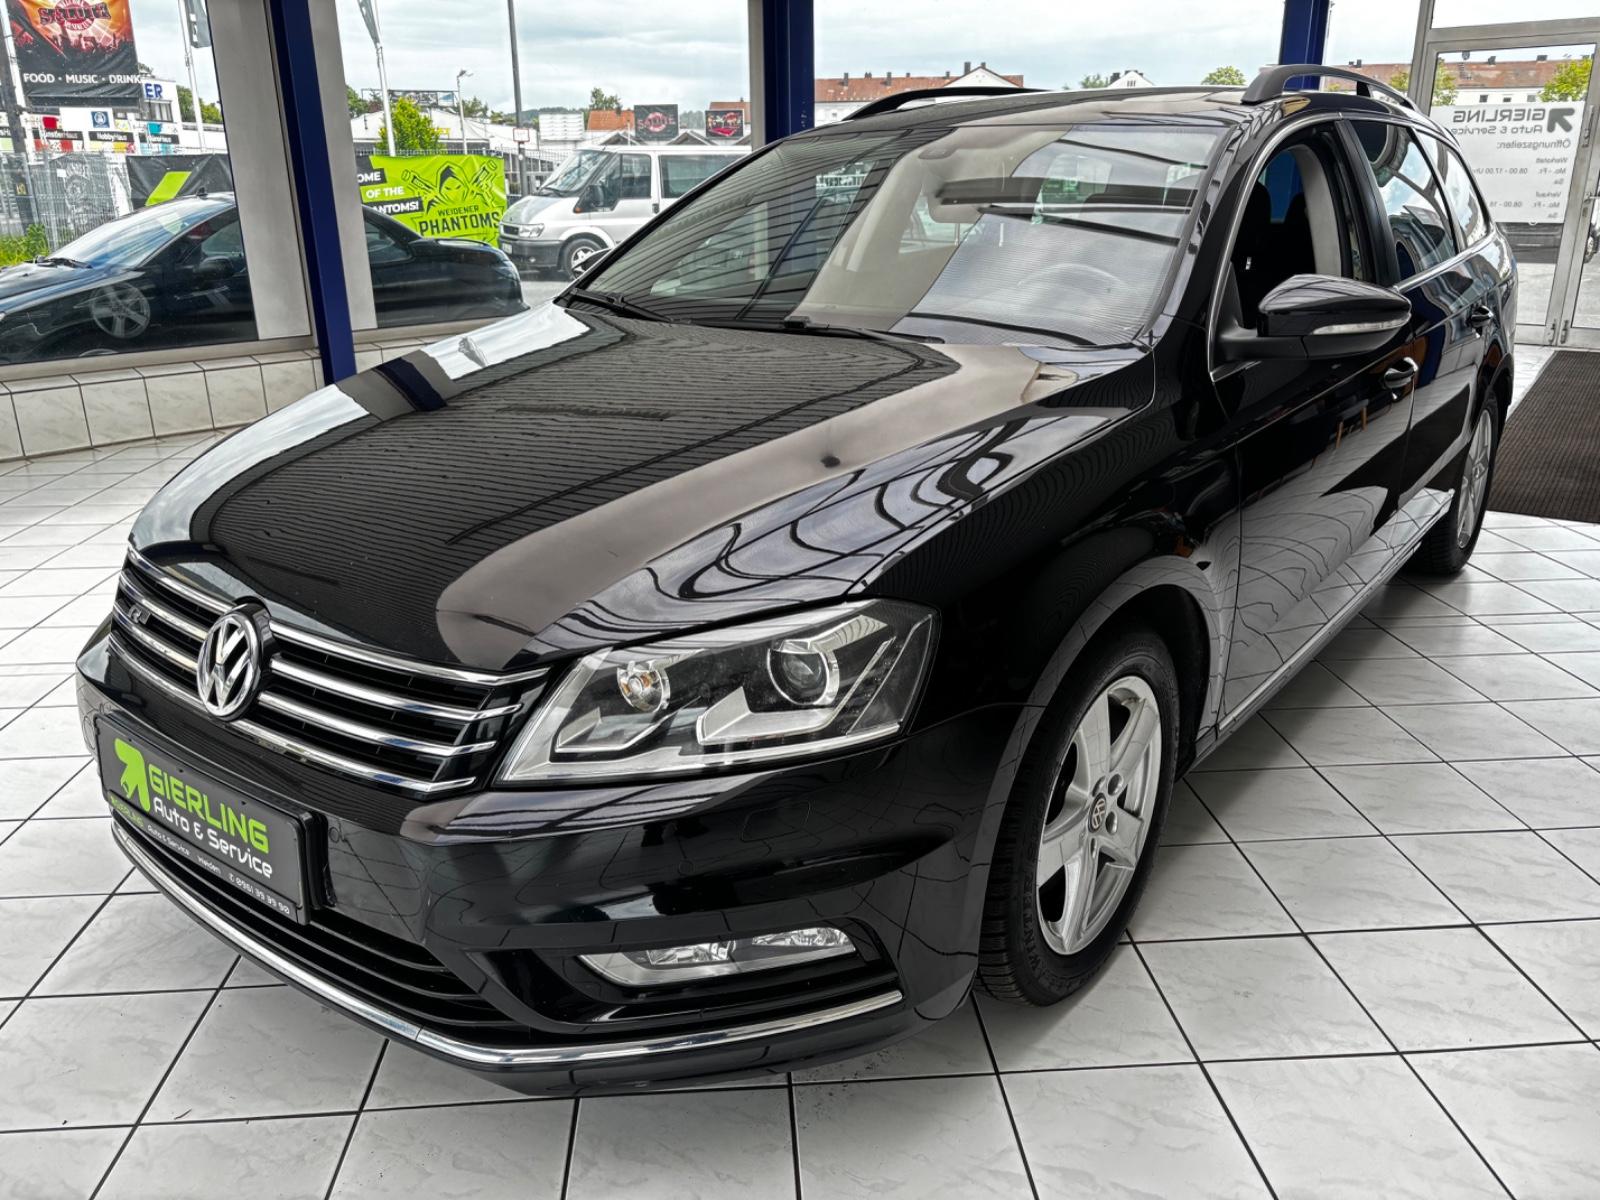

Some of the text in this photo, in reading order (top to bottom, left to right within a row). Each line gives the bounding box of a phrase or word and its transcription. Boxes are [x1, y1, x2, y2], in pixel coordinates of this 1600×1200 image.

[23, 73, 55, 83] FOOD
[66, 74, 98, 83] MUSIC
[144, 83, 163, 98] ER
[365, 186, 405, 199] OF THE
[437, 205, 480, 216] WEIDENER
[418, 211, 500, 237] PHANTOMS
[148, 763, 269, 854] GIERLING
[153, 797, 273, 879] Auto & Service
